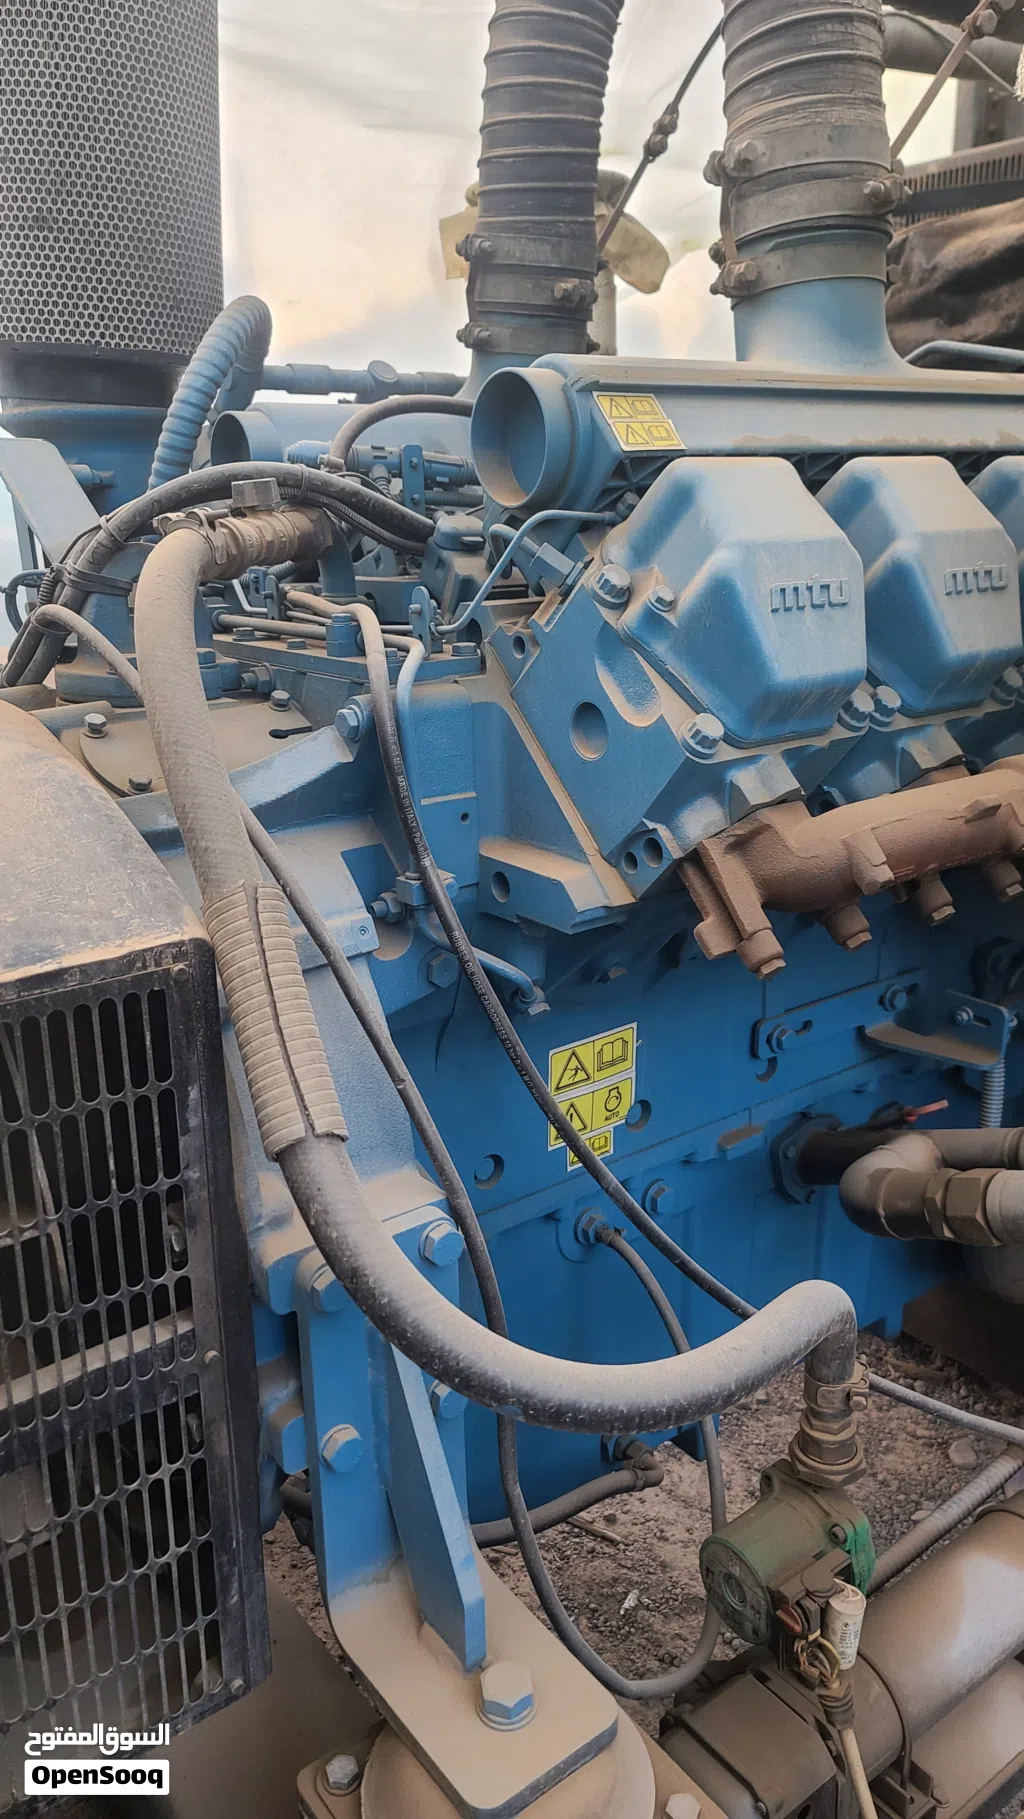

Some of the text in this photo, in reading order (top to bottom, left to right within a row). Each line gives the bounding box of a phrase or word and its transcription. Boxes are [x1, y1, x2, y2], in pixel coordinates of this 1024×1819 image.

[770, 574, 850, 612] mtu
[944, 561, 1008, 596] mtu
[396, 775, 409, 797] MADE
[404, 806, 417, 827] ITALY
[450, 930, 469, 961] RUBBER
[465, 961, 475, 975] OIL
[470, 974, 485, 995] HOSE
[480, 995, 508, 1040] CARBOPRESS
[604, 1111, 620, 1122] AUTO
